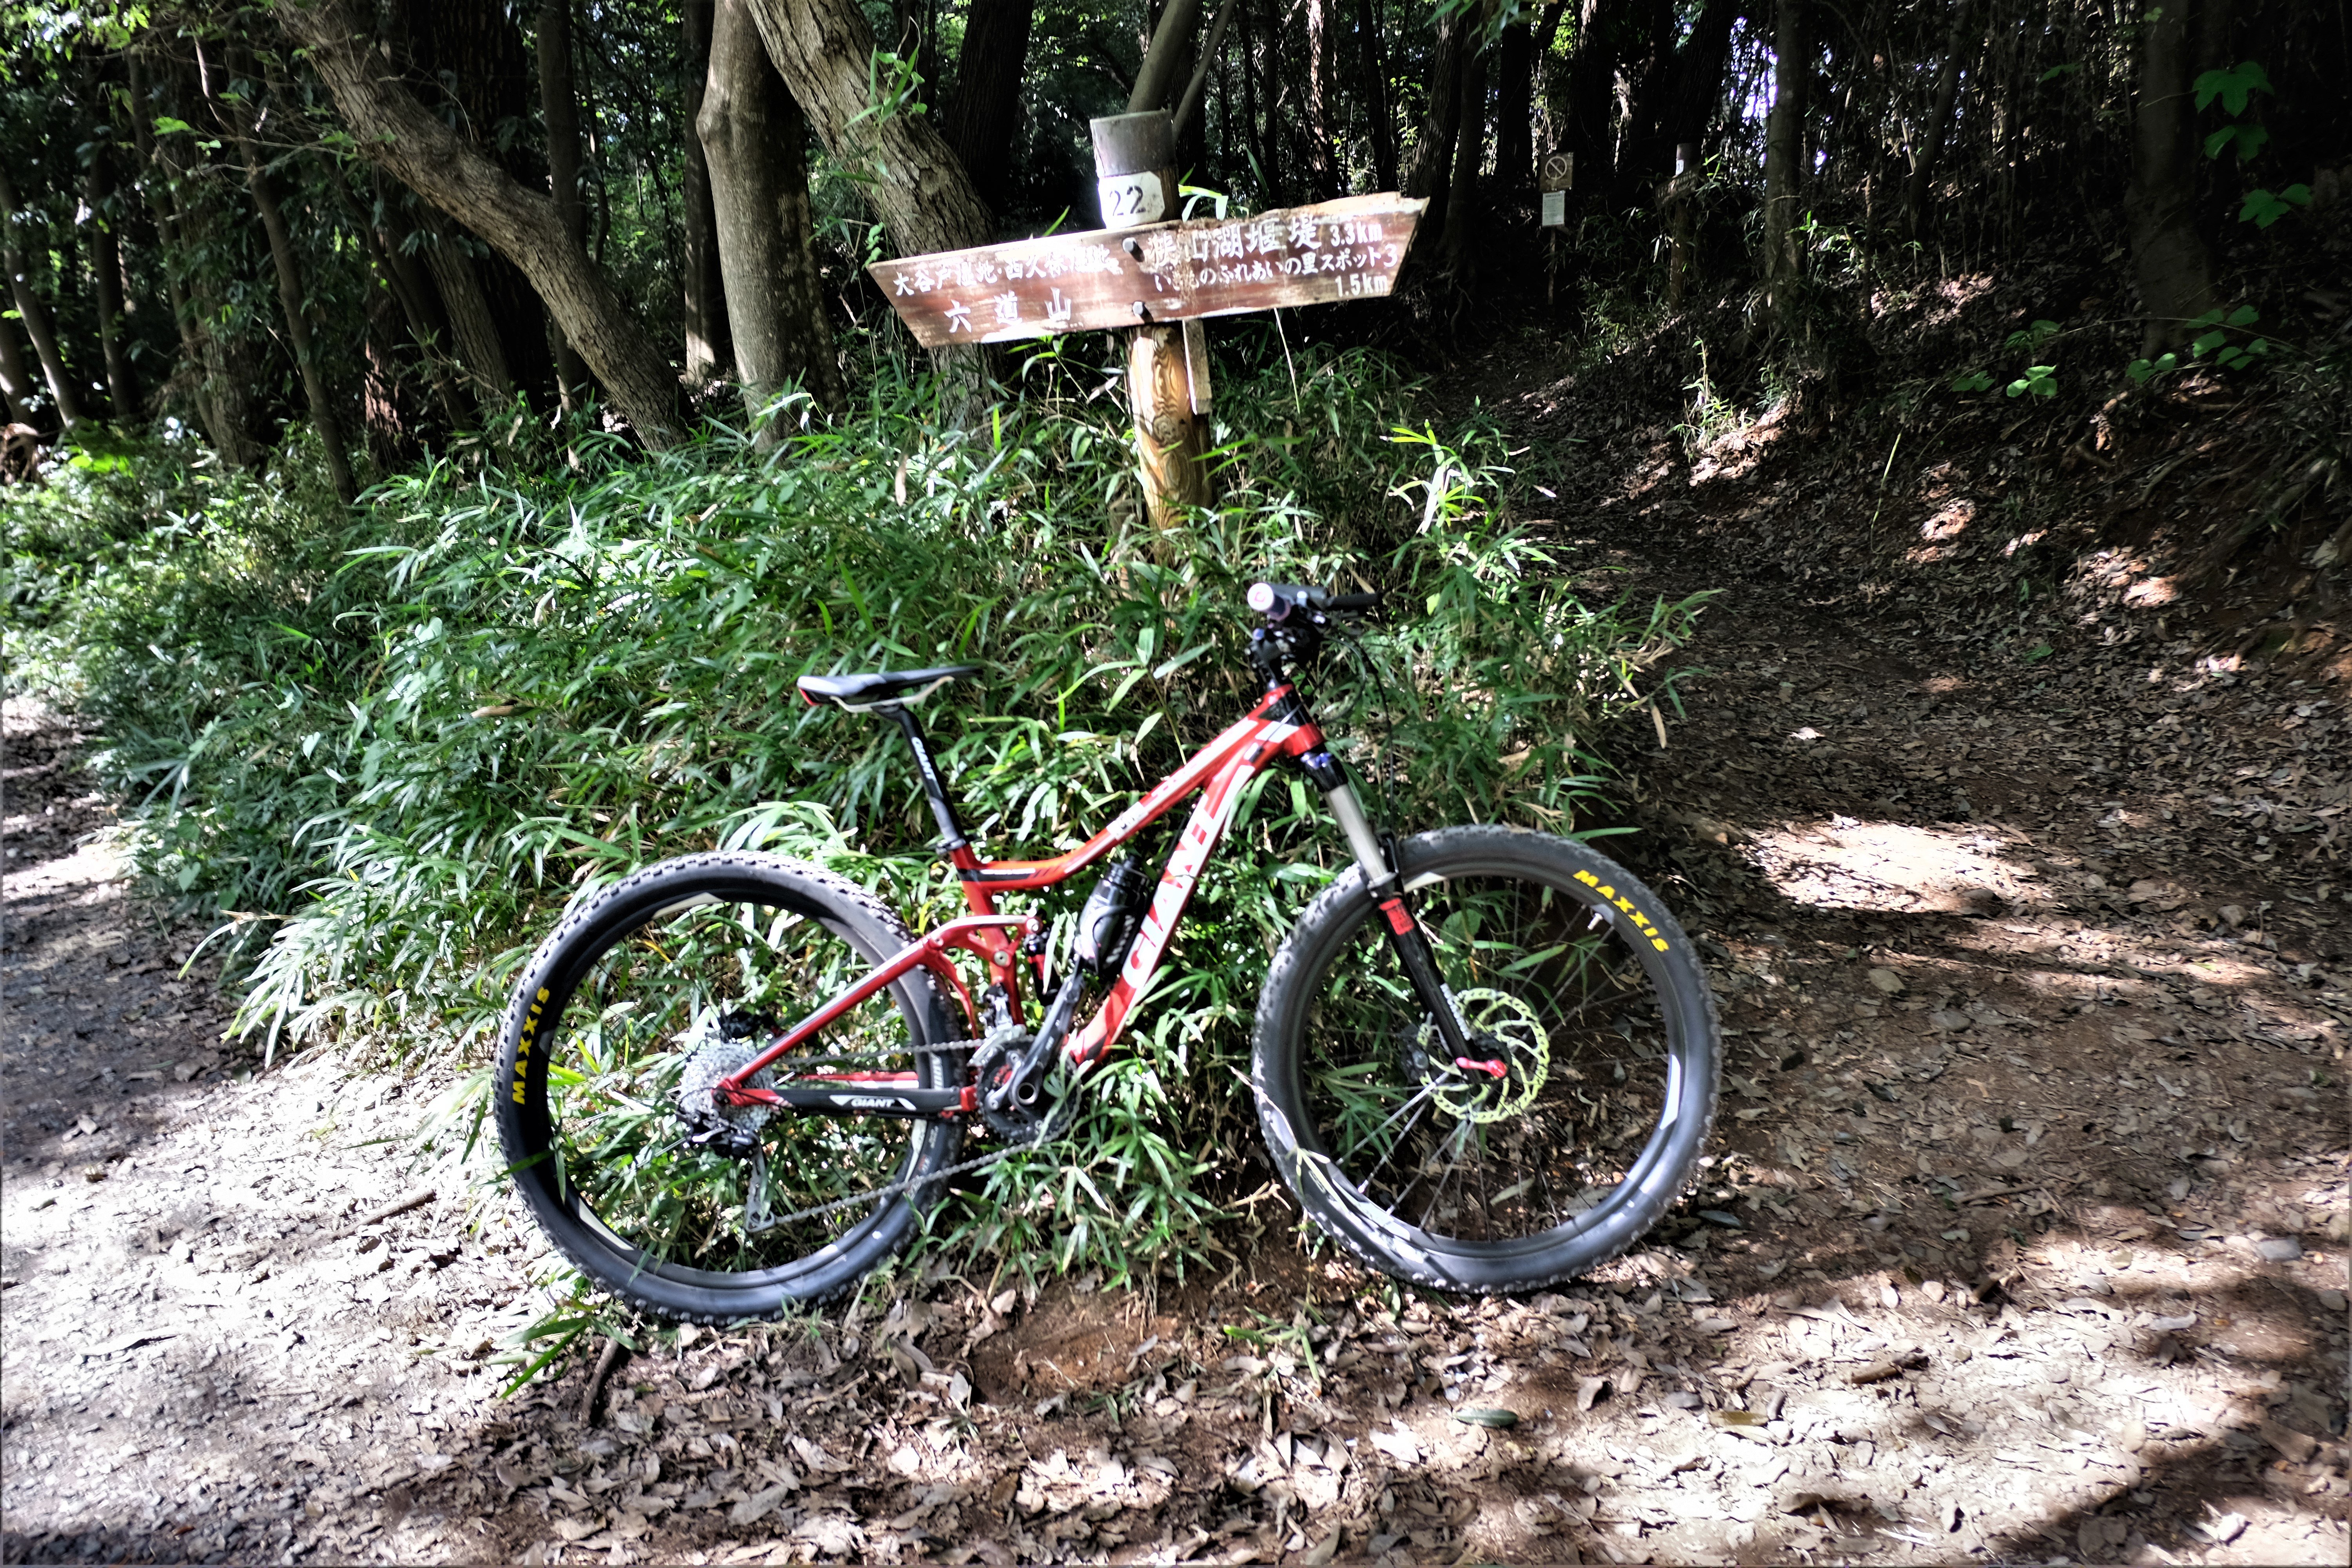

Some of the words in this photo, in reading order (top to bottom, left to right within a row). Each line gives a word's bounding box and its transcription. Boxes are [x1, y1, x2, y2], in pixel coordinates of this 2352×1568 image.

[1109, 185, 1146, 216] 22
[1329, 221, 1383, 247] 3.3km
[1335, 272, 1388, 298] 1.5km
[944, 287, 1072, 333] 六道山
[1122, 794, 1222, 990] GIANT
[1572, 869, 1670, 952] MAXXIS
[512, 986, 550, 1105] MAXXIS
[851, 1098, 895, 1108] GIANT
